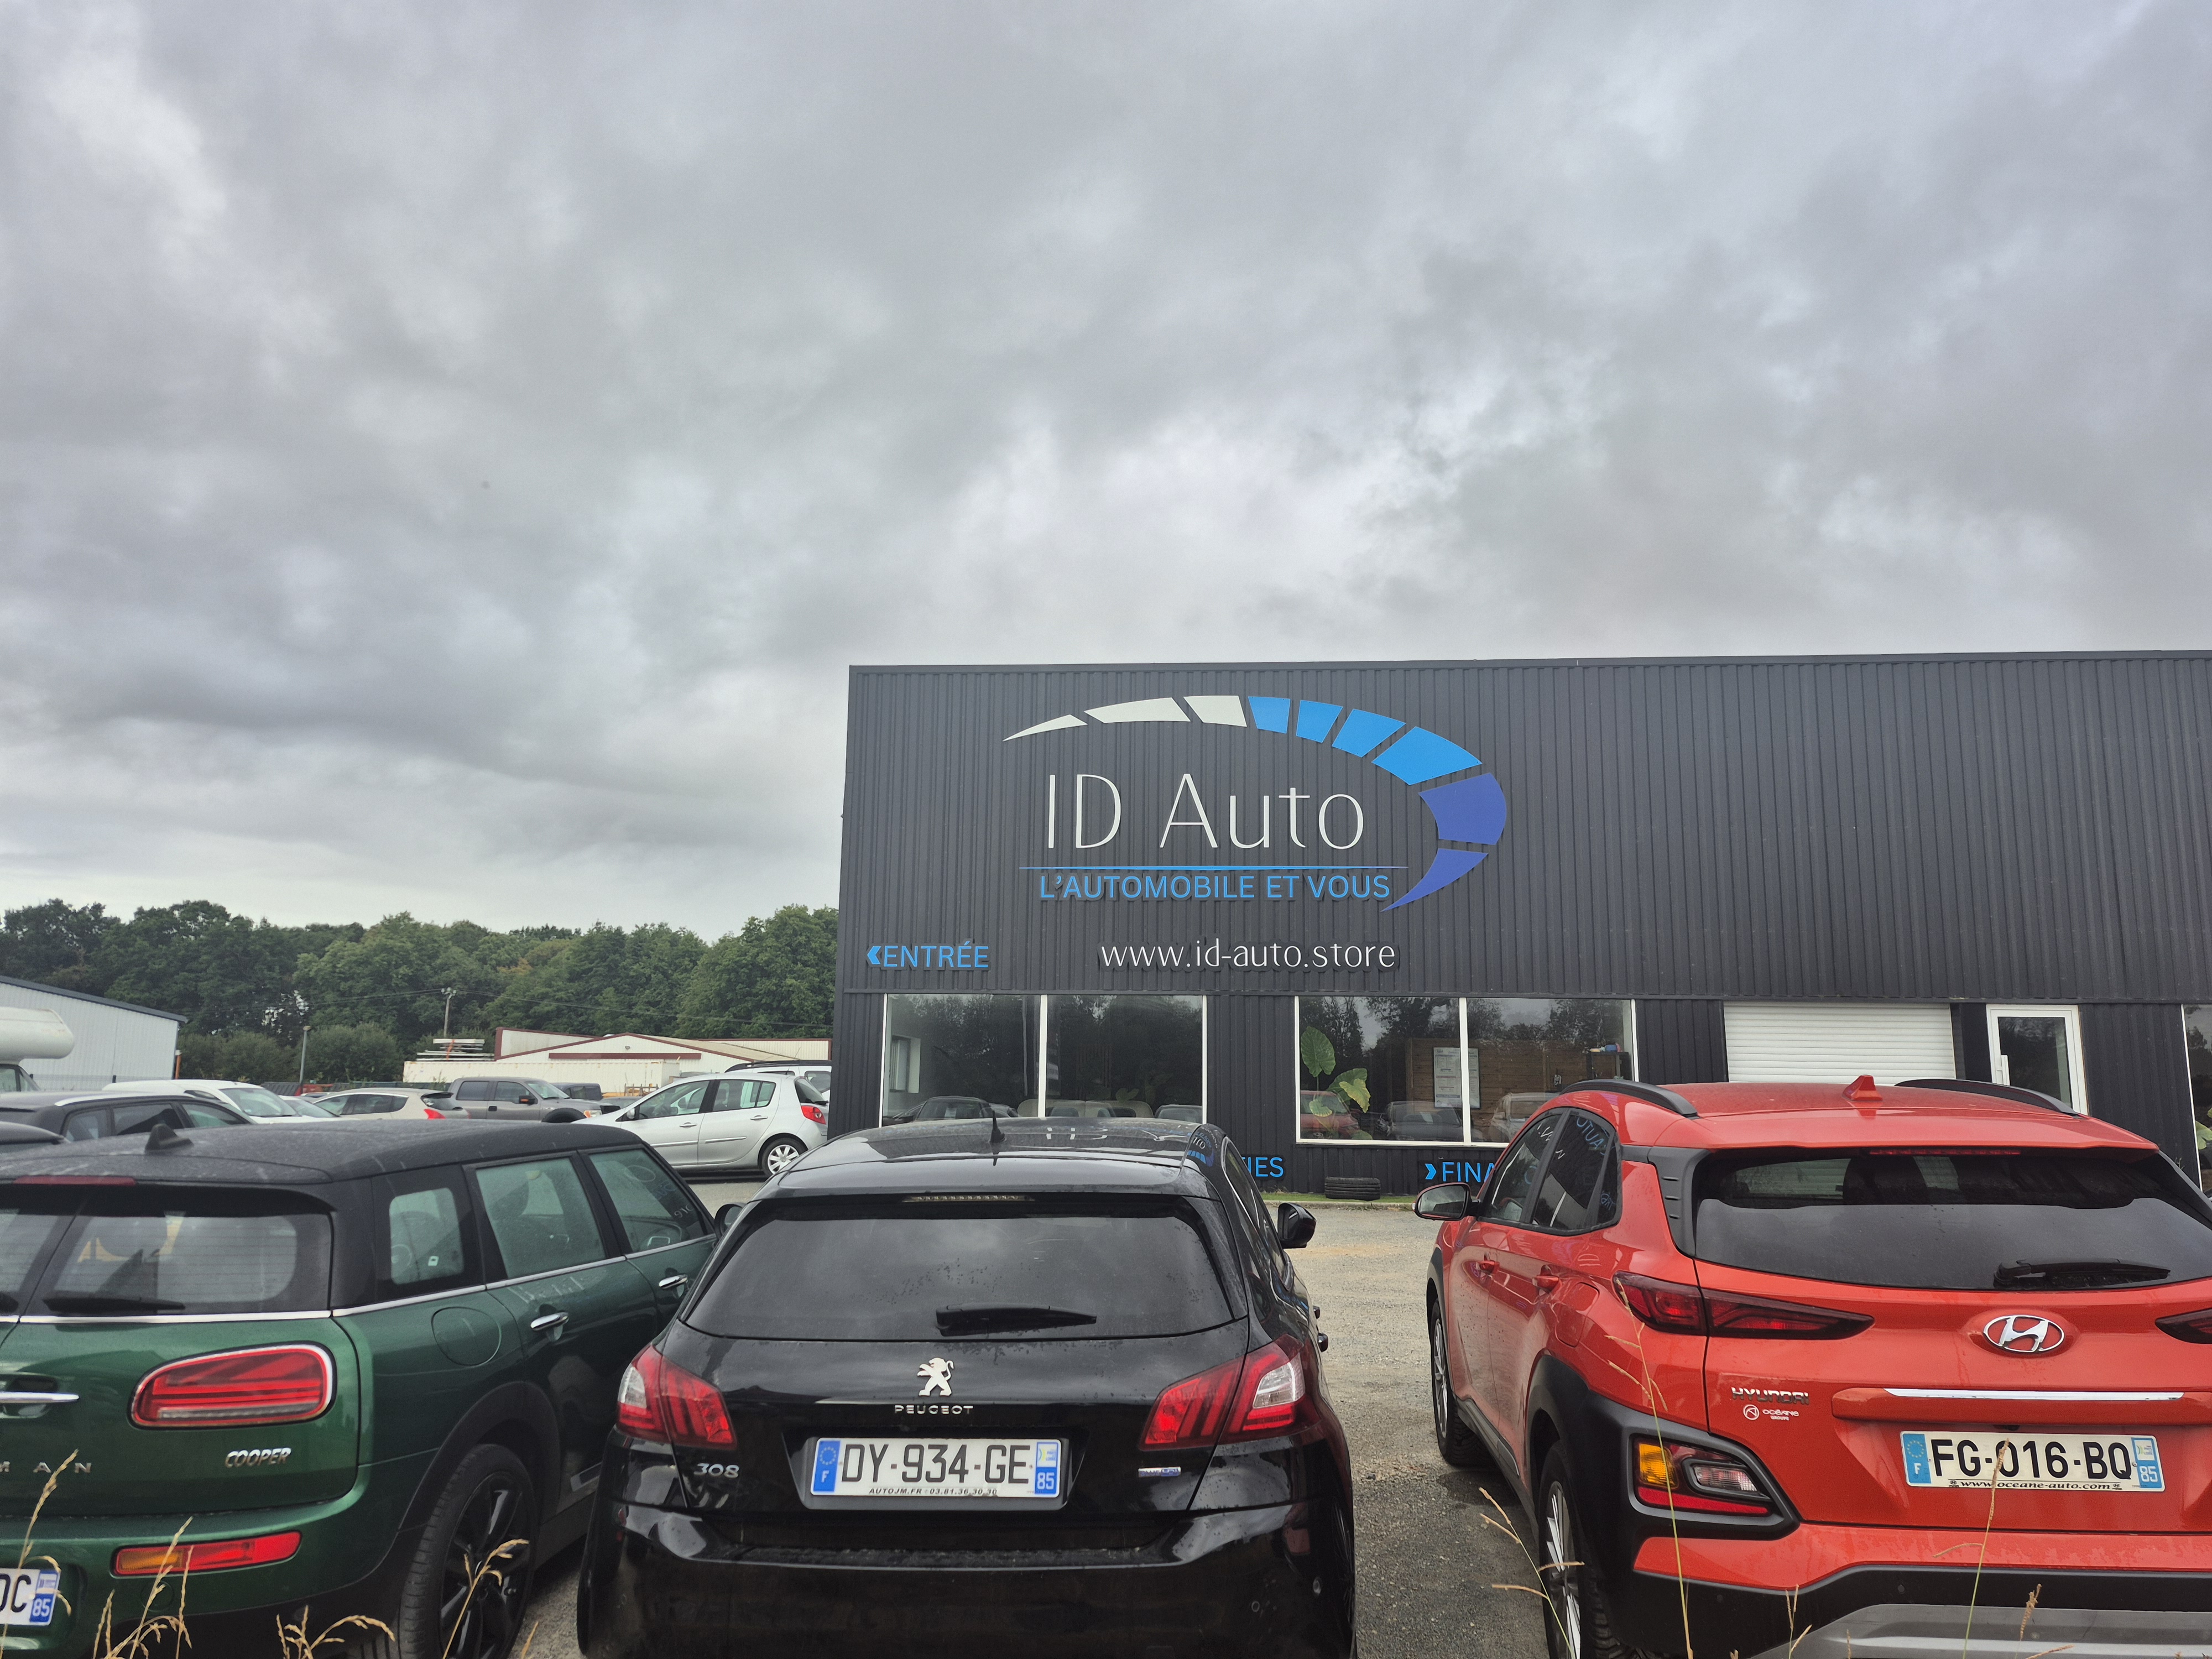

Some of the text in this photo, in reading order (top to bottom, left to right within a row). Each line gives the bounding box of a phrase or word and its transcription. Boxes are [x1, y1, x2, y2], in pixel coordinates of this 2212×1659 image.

[1048, 773, 1364, 849] ID Auto
[1266, 875, 1300, 899] ET
[1307, 875, 1391, 899] VOUS
[884, 941, 989, 968] ENTRÉE
[1100, 937, 1395, 968] www.id-auto.store
[1241, 1156, 1284, 1178] IES
[1731, 1387, 1809, 1405] HYUNDAI
[894, 1405, 974, 1415] PEUGEOT
[225, 1447, 291, 1468] COOPER
[842, 1444, 1031, 1484] DY-934-GE
[1931, 1439, 2132, 1480] FG-016-BQ
[693, 1463, 740, 1479] 308
[821, 1470, 830, 1483] F
[1914, 1463, 1921, 1475] F
[2140, 1466, 2158, 1482] 85
[1037, 1472, 1055, 1490] 85
[33, 1598, 51, 1617] 85
